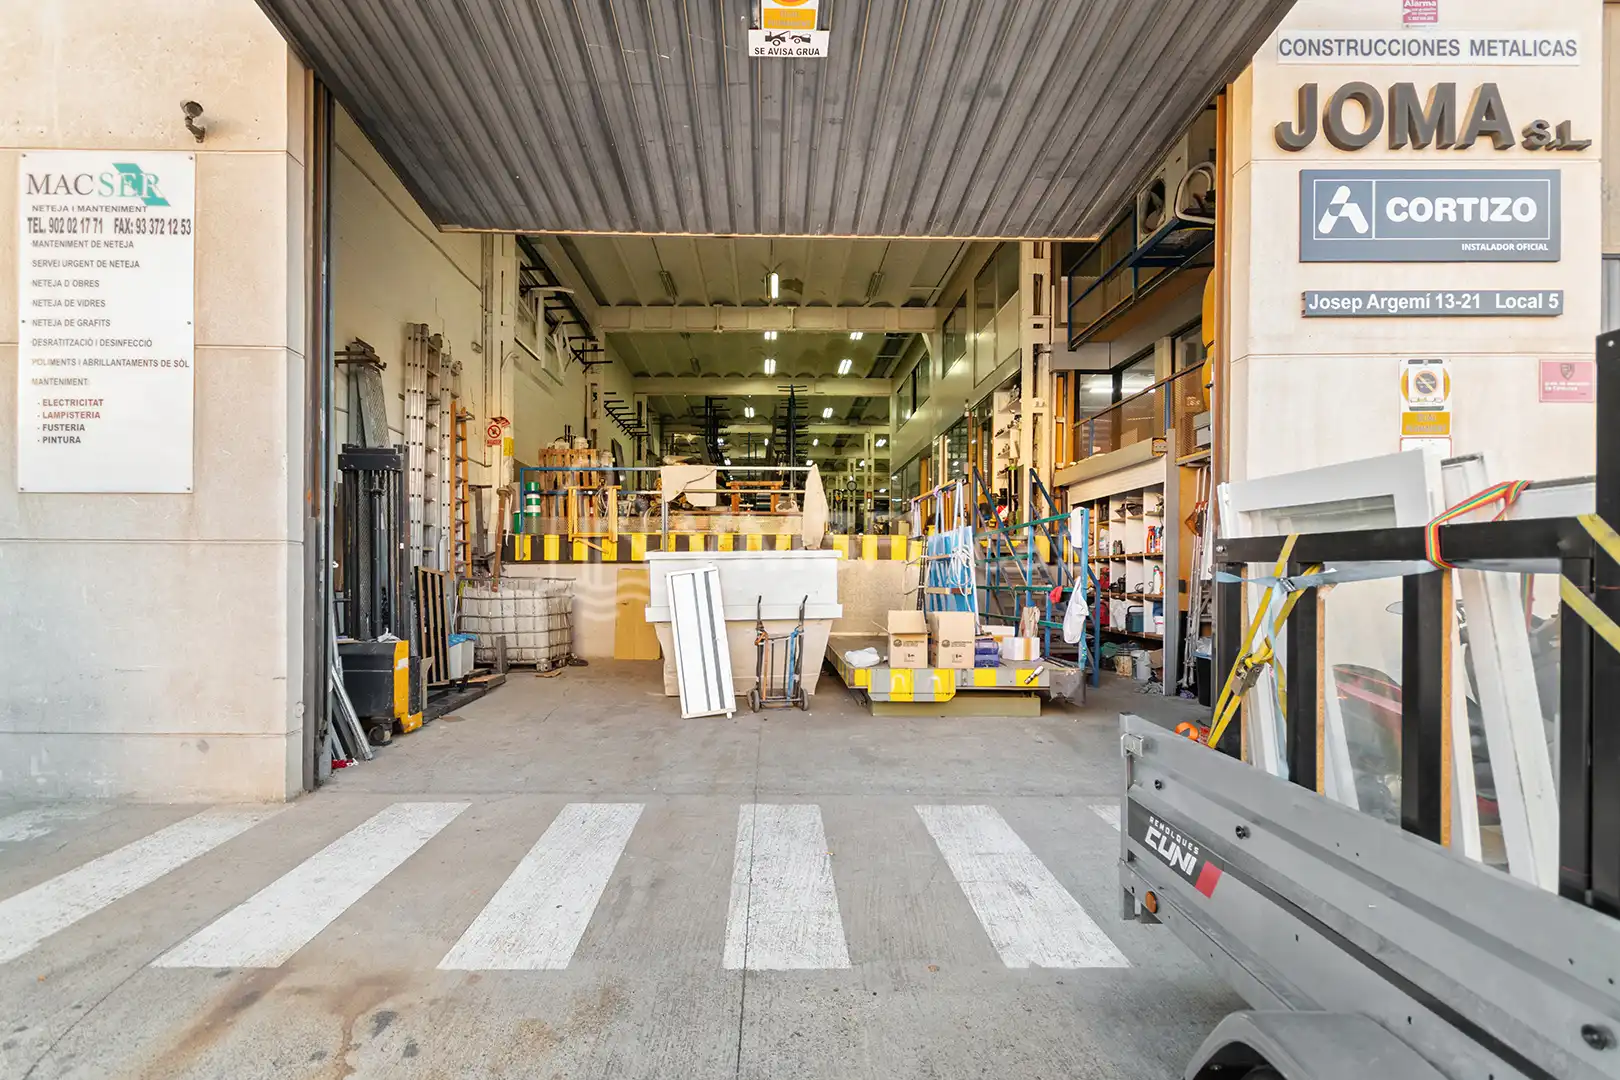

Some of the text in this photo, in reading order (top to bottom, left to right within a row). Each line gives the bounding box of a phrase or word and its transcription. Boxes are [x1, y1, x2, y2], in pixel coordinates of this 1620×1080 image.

[1279, 38, 1578, 57] CONSTRUCCIONES METALICAS
[1274, 82, 1516, 152] JOMA
[1386, 196, 1537, 222] CORTIZO
[28, 217, 192, 235] TEL. 902 02 17 71 FAX: 93 372 12 53
[1308, 292, 1559, 312] Josep Argemí 13-21 Local 5
[83, 359, 158, 367] ABRILLANTAMENTS
[1149, 816, 1199, 855] REMOLQUES
